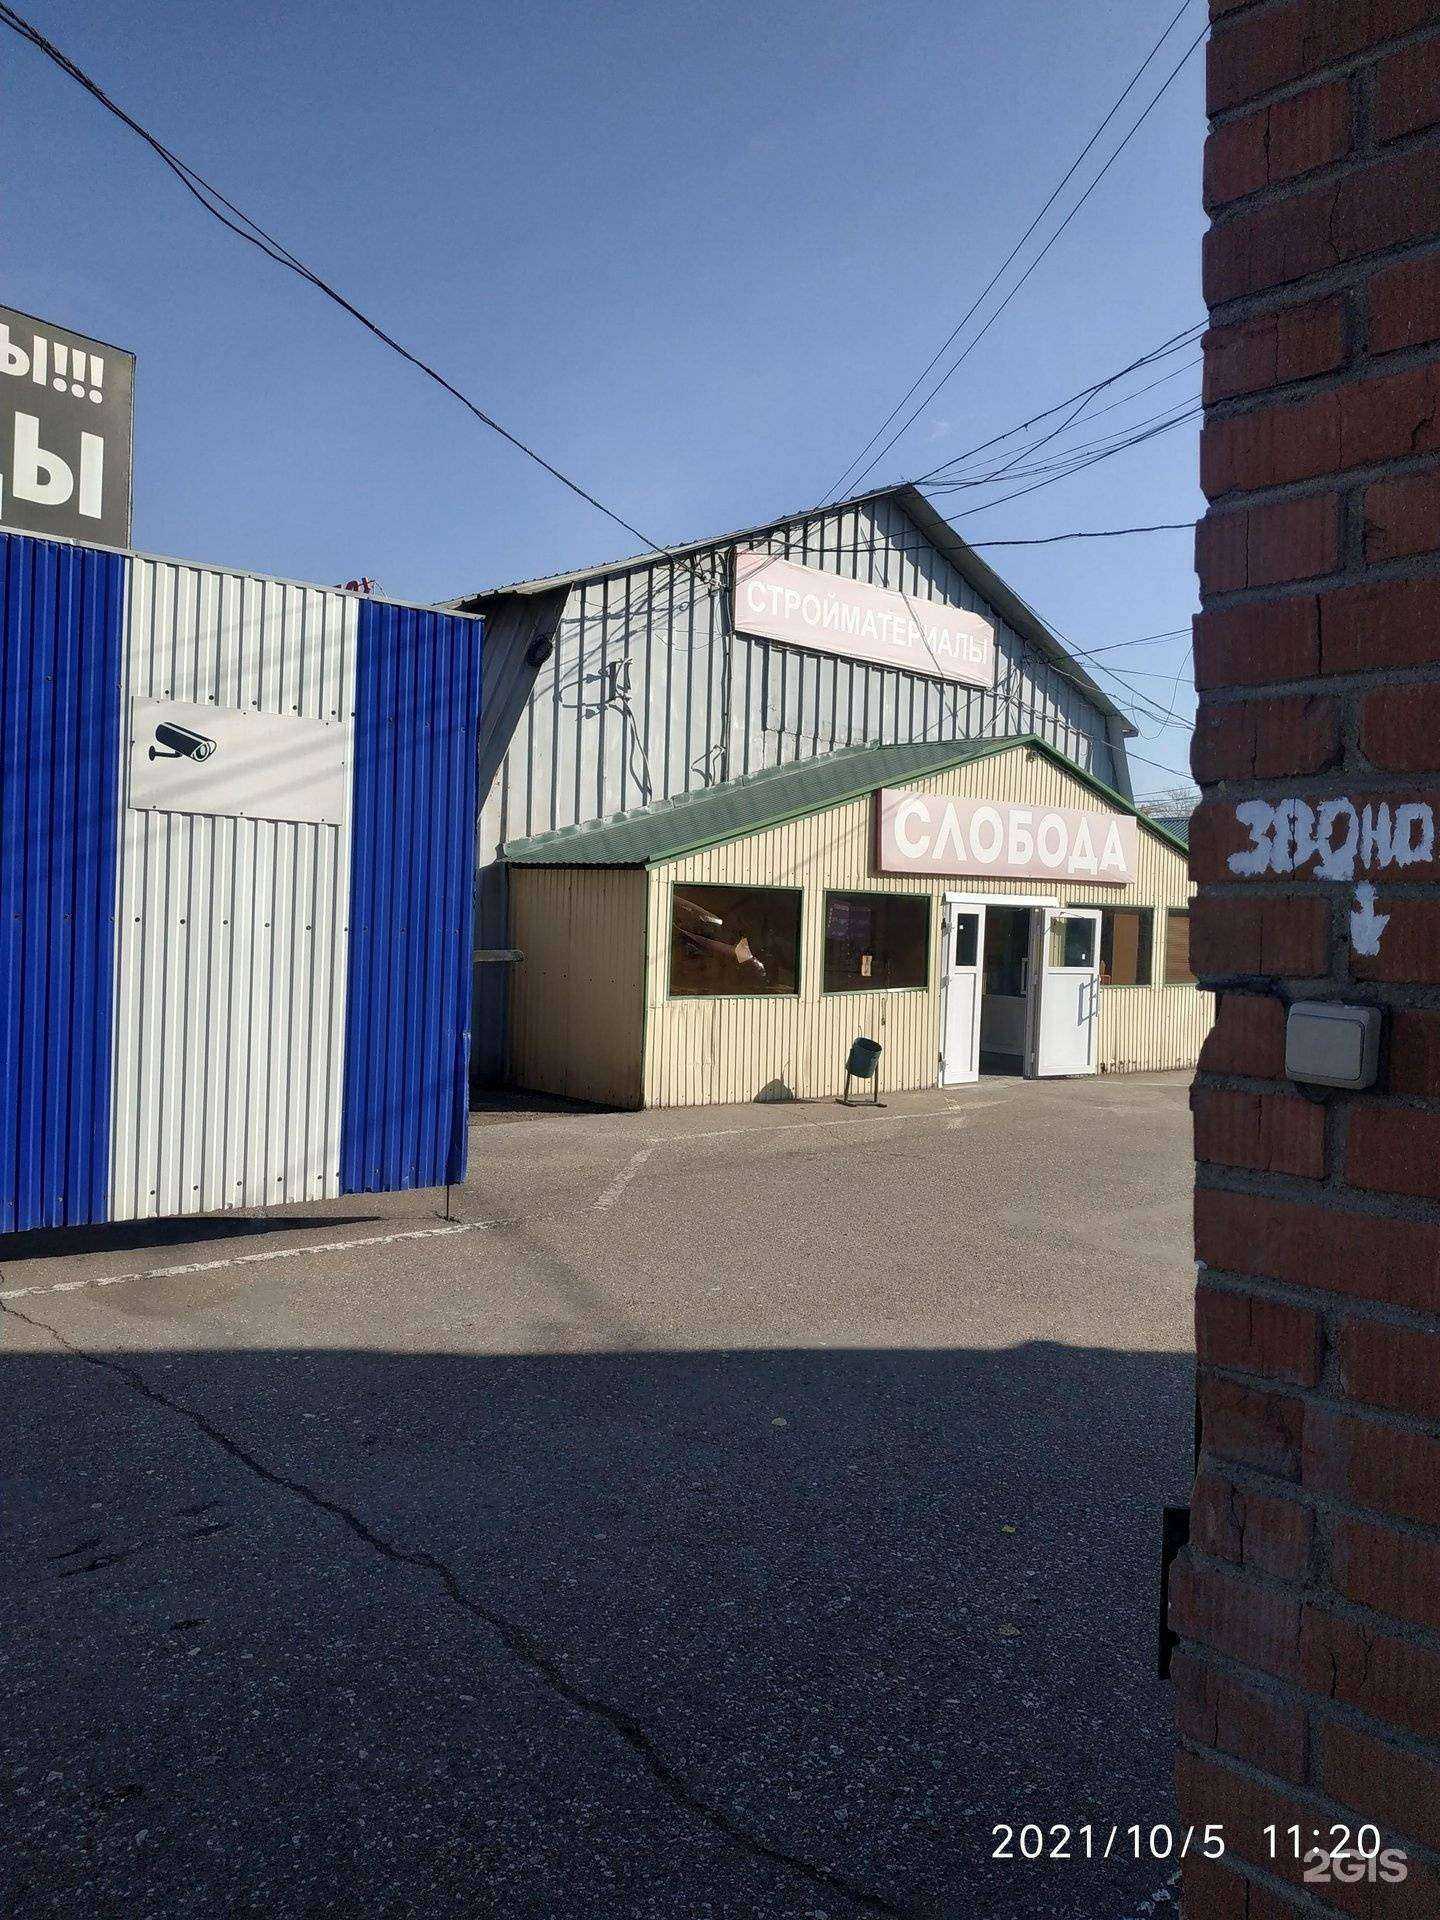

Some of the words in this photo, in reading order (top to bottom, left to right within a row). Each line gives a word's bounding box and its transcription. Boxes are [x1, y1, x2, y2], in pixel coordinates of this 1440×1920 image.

[0, 411, 104, 519] Ы
[747, 581, 988, 664] СТРОЙМАТЕРИАЛЫ
[894, 799, 1128, 874] СЛОБОДА
